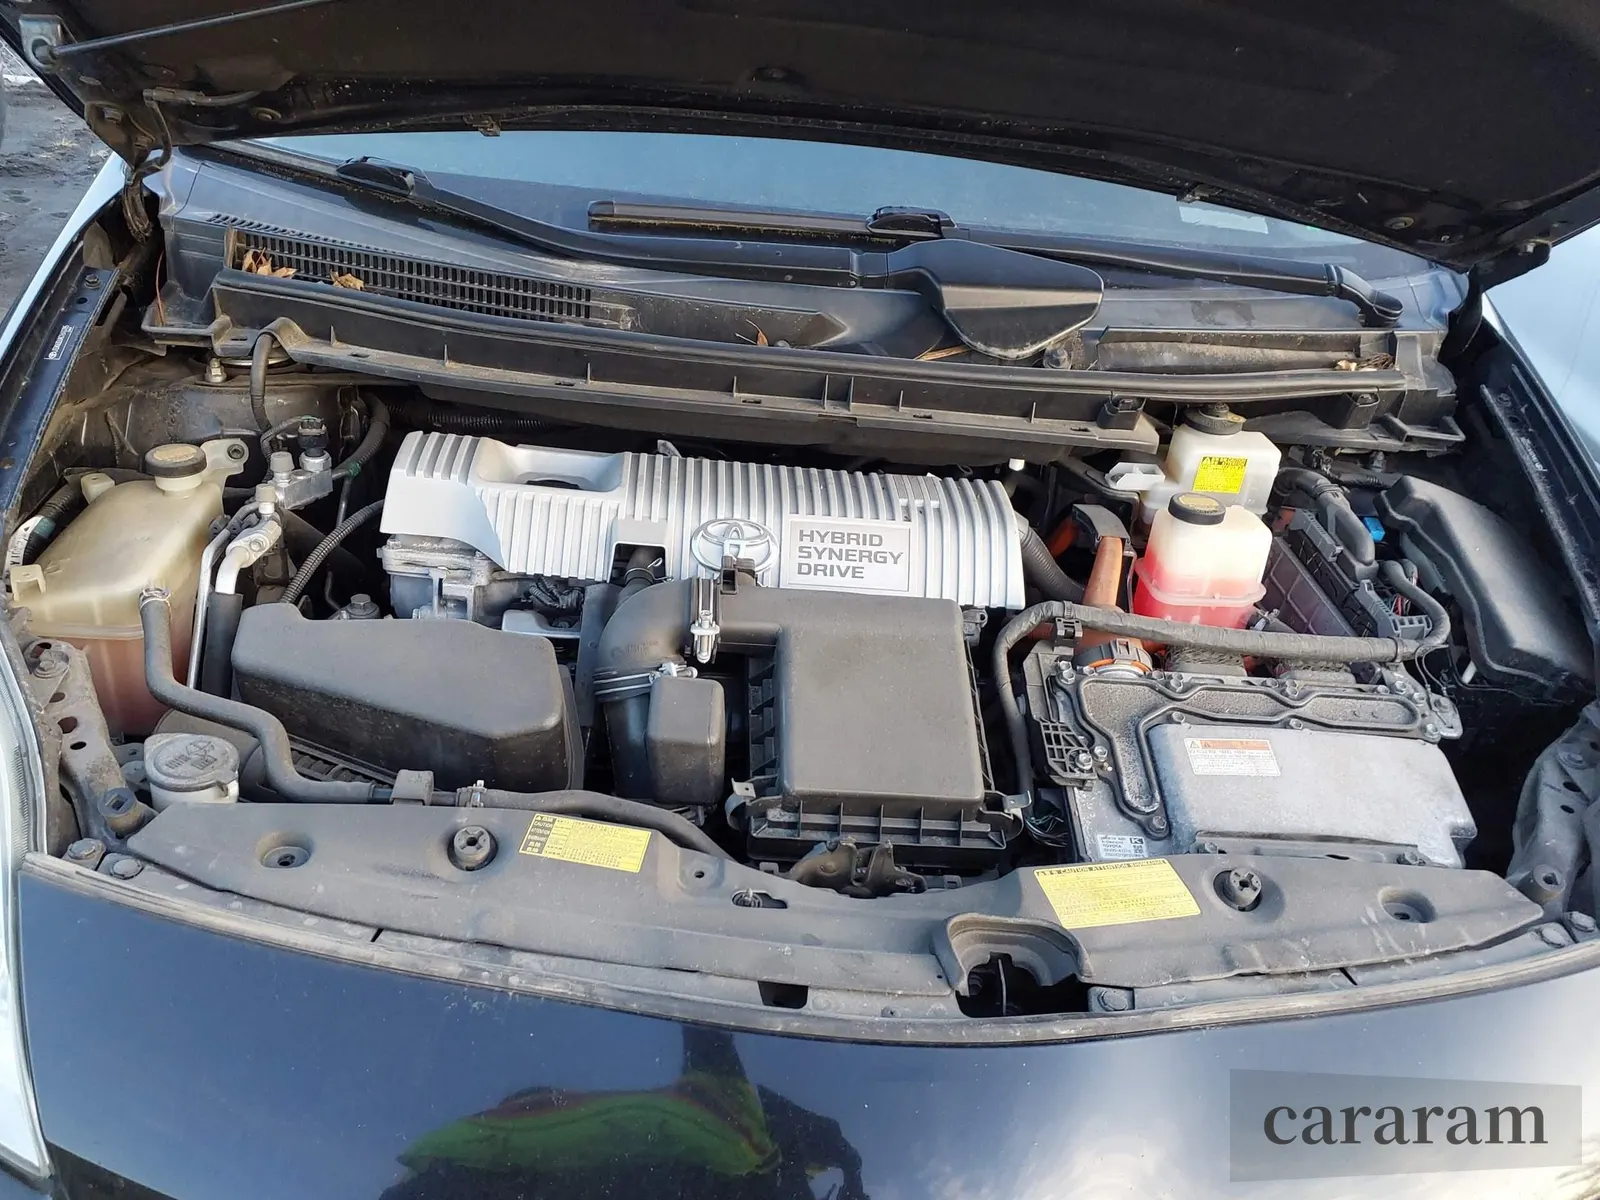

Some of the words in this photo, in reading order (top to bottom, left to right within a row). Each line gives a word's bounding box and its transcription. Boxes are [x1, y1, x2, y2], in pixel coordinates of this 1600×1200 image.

[799, 529, 883, 546] HYBRID
[798, 545, 904, 564] SYNERGY
[797, 562, 865, 579] DRIVE
